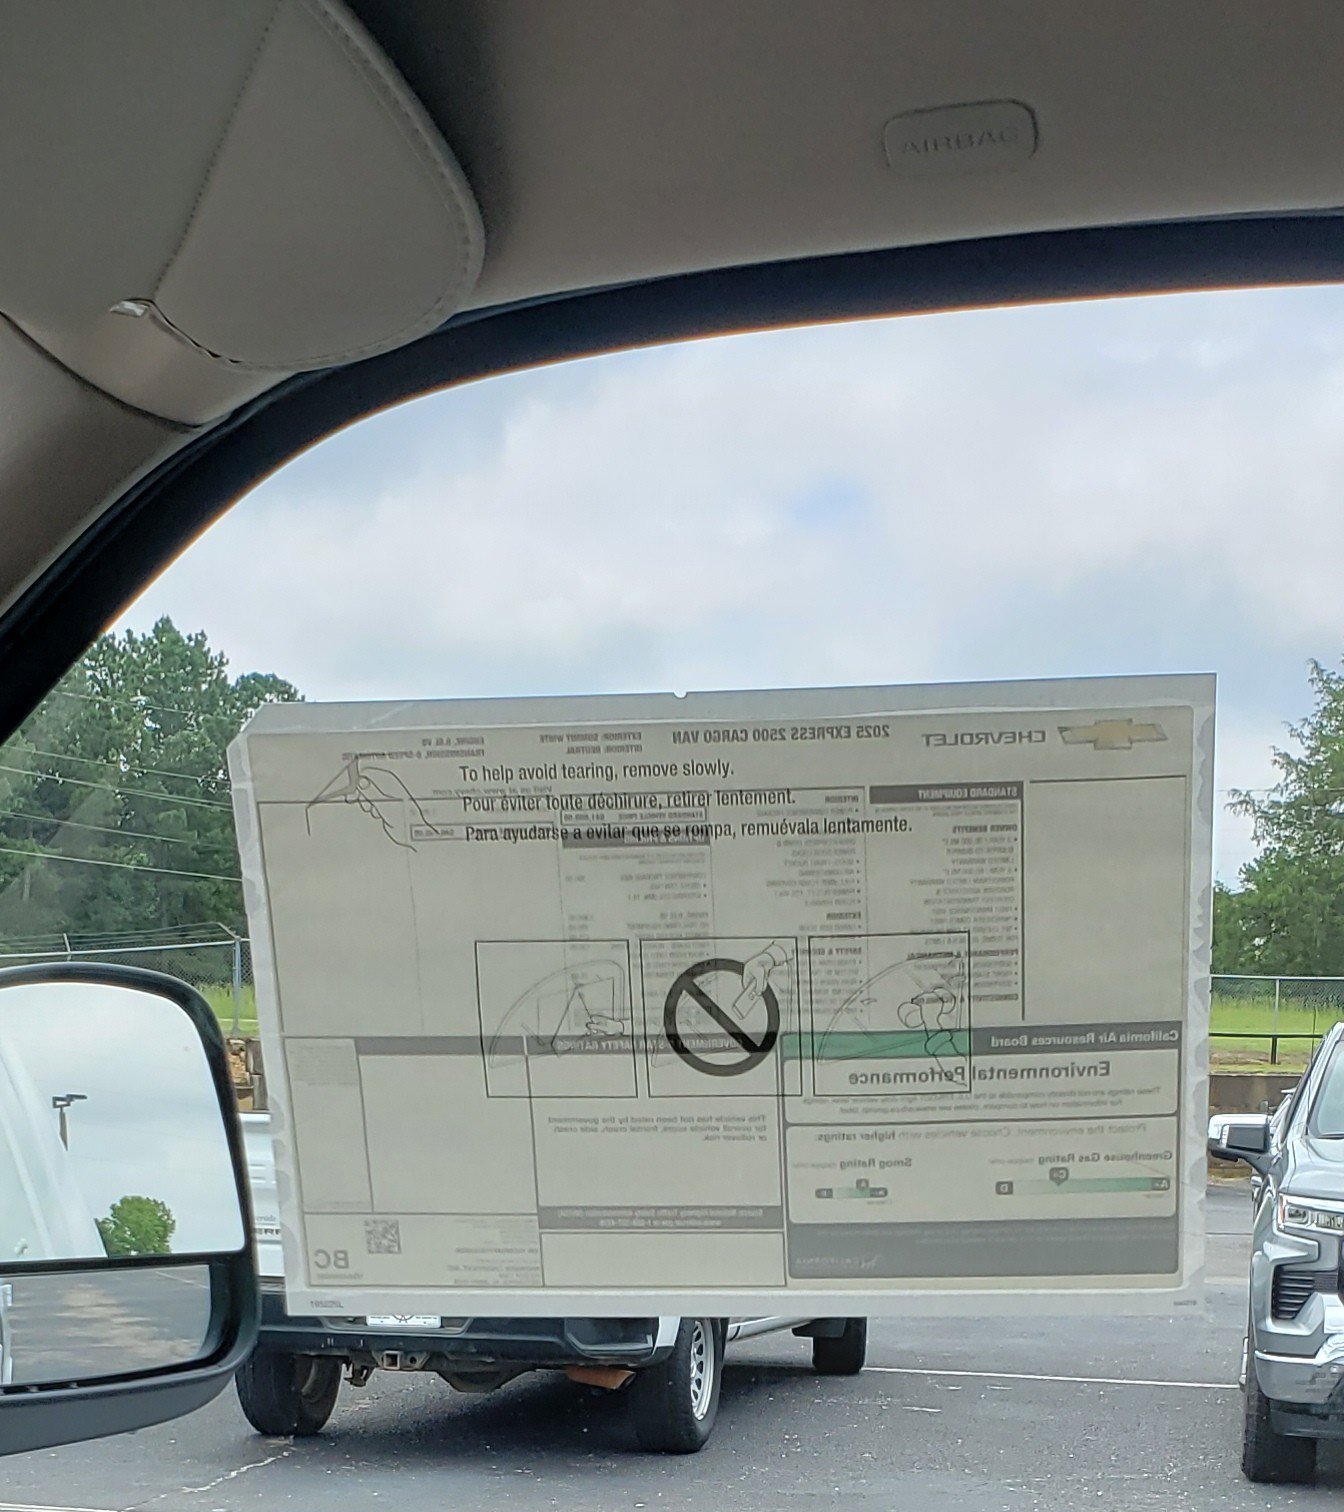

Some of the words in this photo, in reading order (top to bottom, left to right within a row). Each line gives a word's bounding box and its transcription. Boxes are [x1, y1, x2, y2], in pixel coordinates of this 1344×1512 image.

[459, 766, 479, 782] To
[483, 764, 515, 784] help
[518, 763, 558, 780] avoid
[561, 762, 618, 782] tearing,
[623, 763, 678, 778] remove
[682, 758, 734, 779] slowly.
[462, 795, 496, 812] Pour
[501, 793, 541, 811] éviter
[545, 793, 583, 810] toute
[587, 792, 662, 810] déchirure,
[666, 790, 711, 808] retirer
[716, 788, 796, 807] lentement.
[465, 825, 499, 842] Para
[502, 825, 568, 844] ayudarse
[573, 827, 582, 840] a
[586, 823, 626, 840] evitar
[631, 825, 660, 842] que
[662, 825, 682, 838] se
[685, 823, 736, 841] rompa,
[741, 818, 820, 836] remuévala
[823, 816, 913, 835] lentamente.
